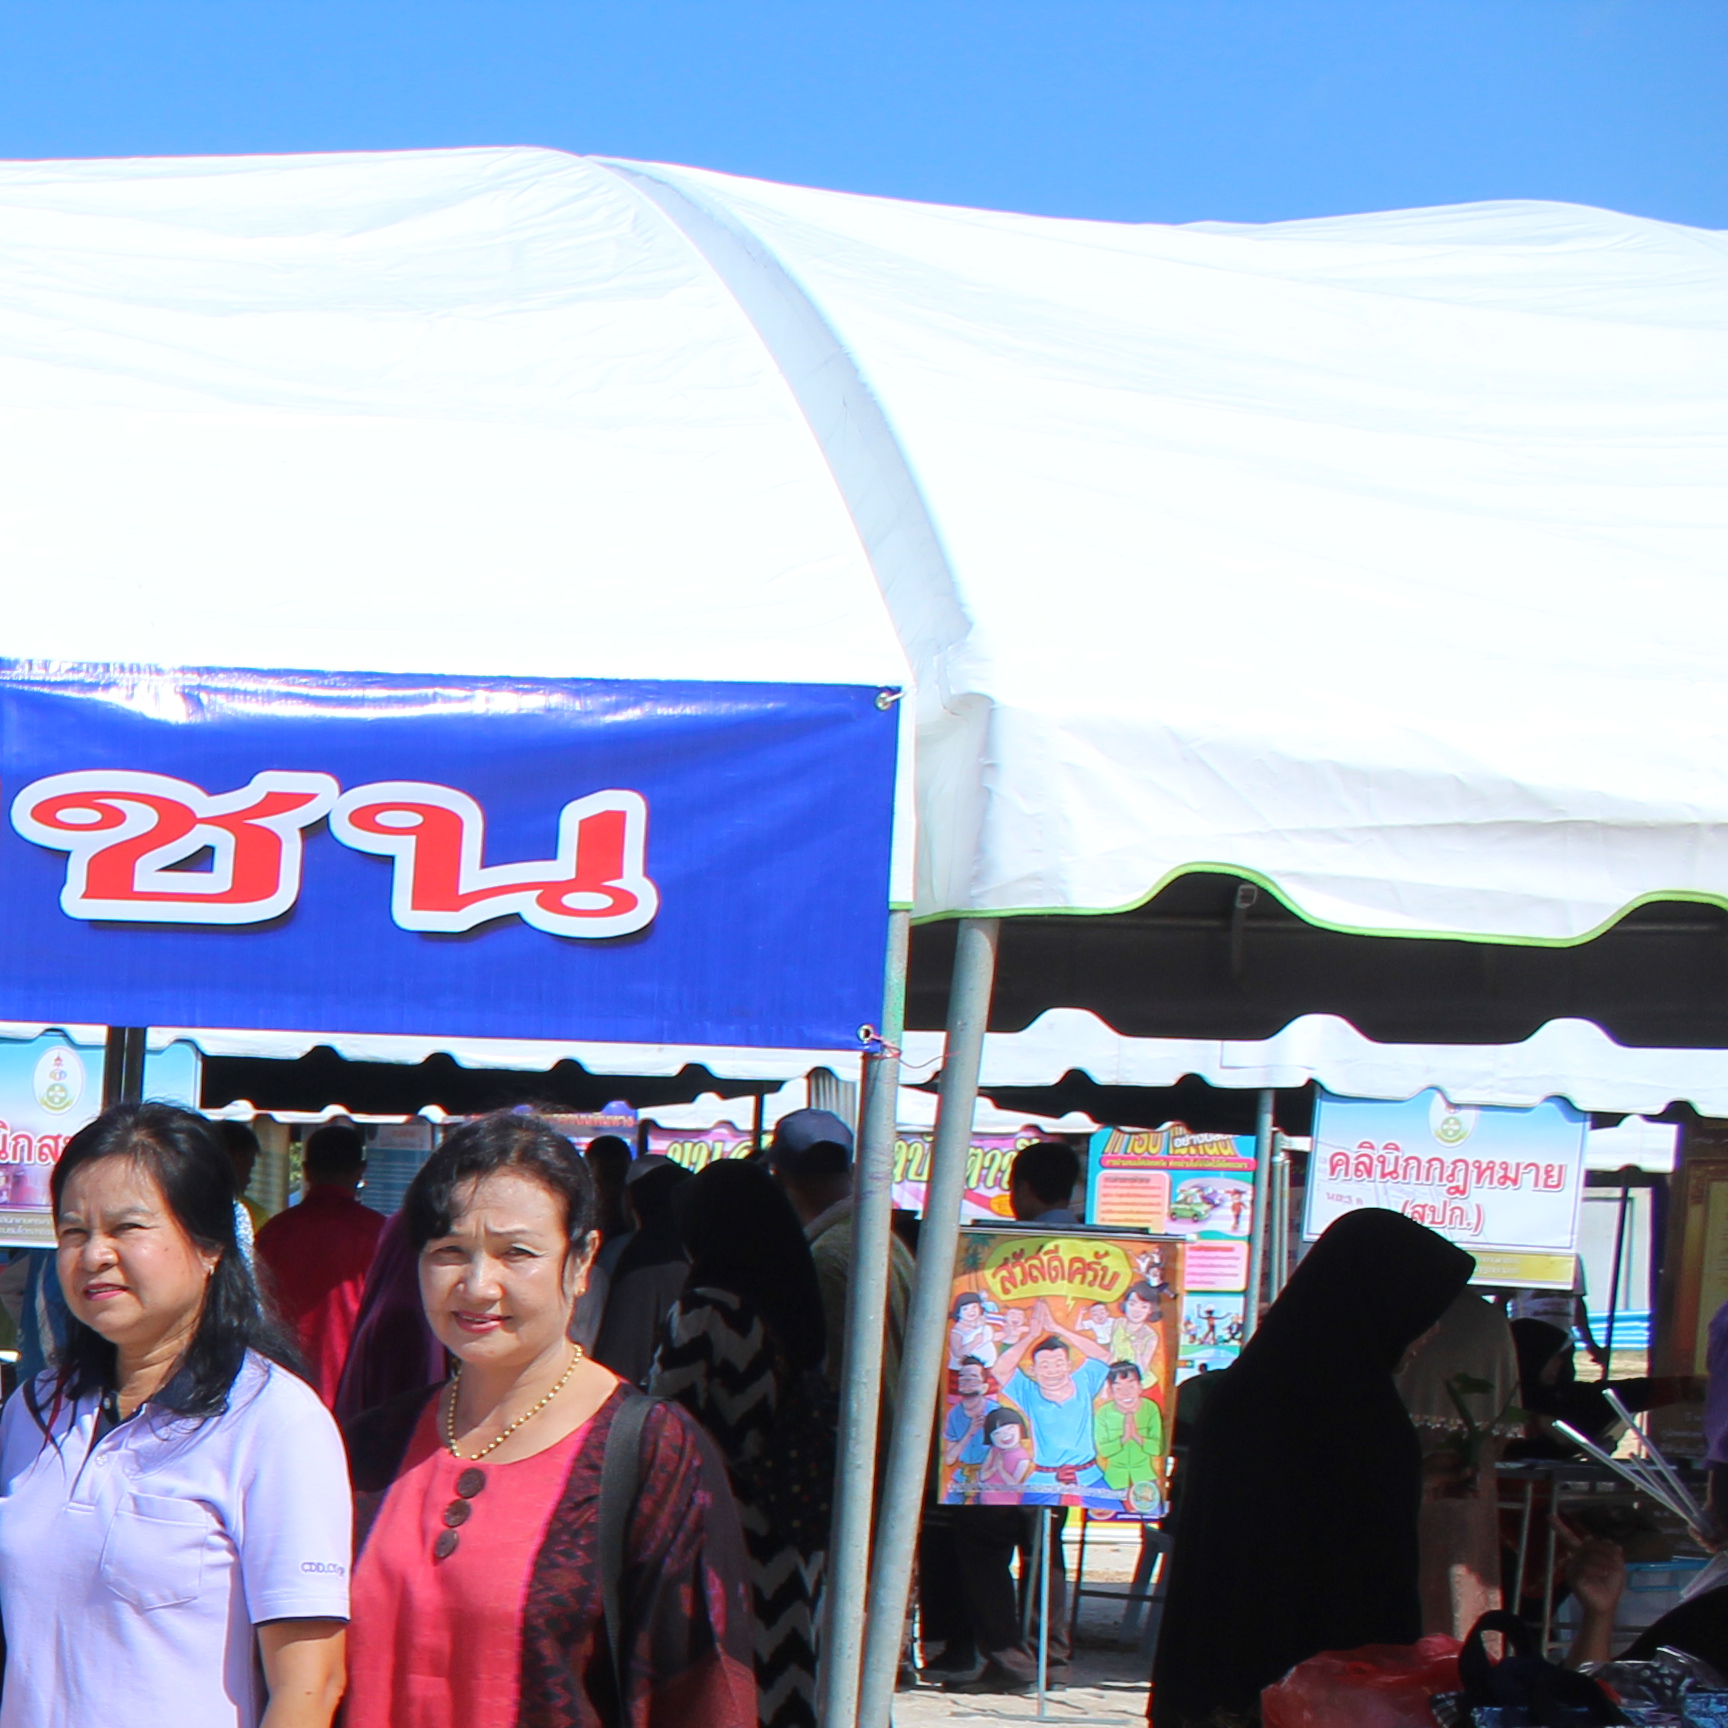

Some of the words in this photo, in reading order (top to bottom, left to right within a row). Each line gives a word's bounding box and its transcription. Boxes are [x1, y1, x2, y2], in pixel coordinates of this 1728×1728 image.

[1327, 1140, 1567, 1198] คลินิกกฎหมาย
[991, 1243, 1121, 1296] สวัสดีครับ
